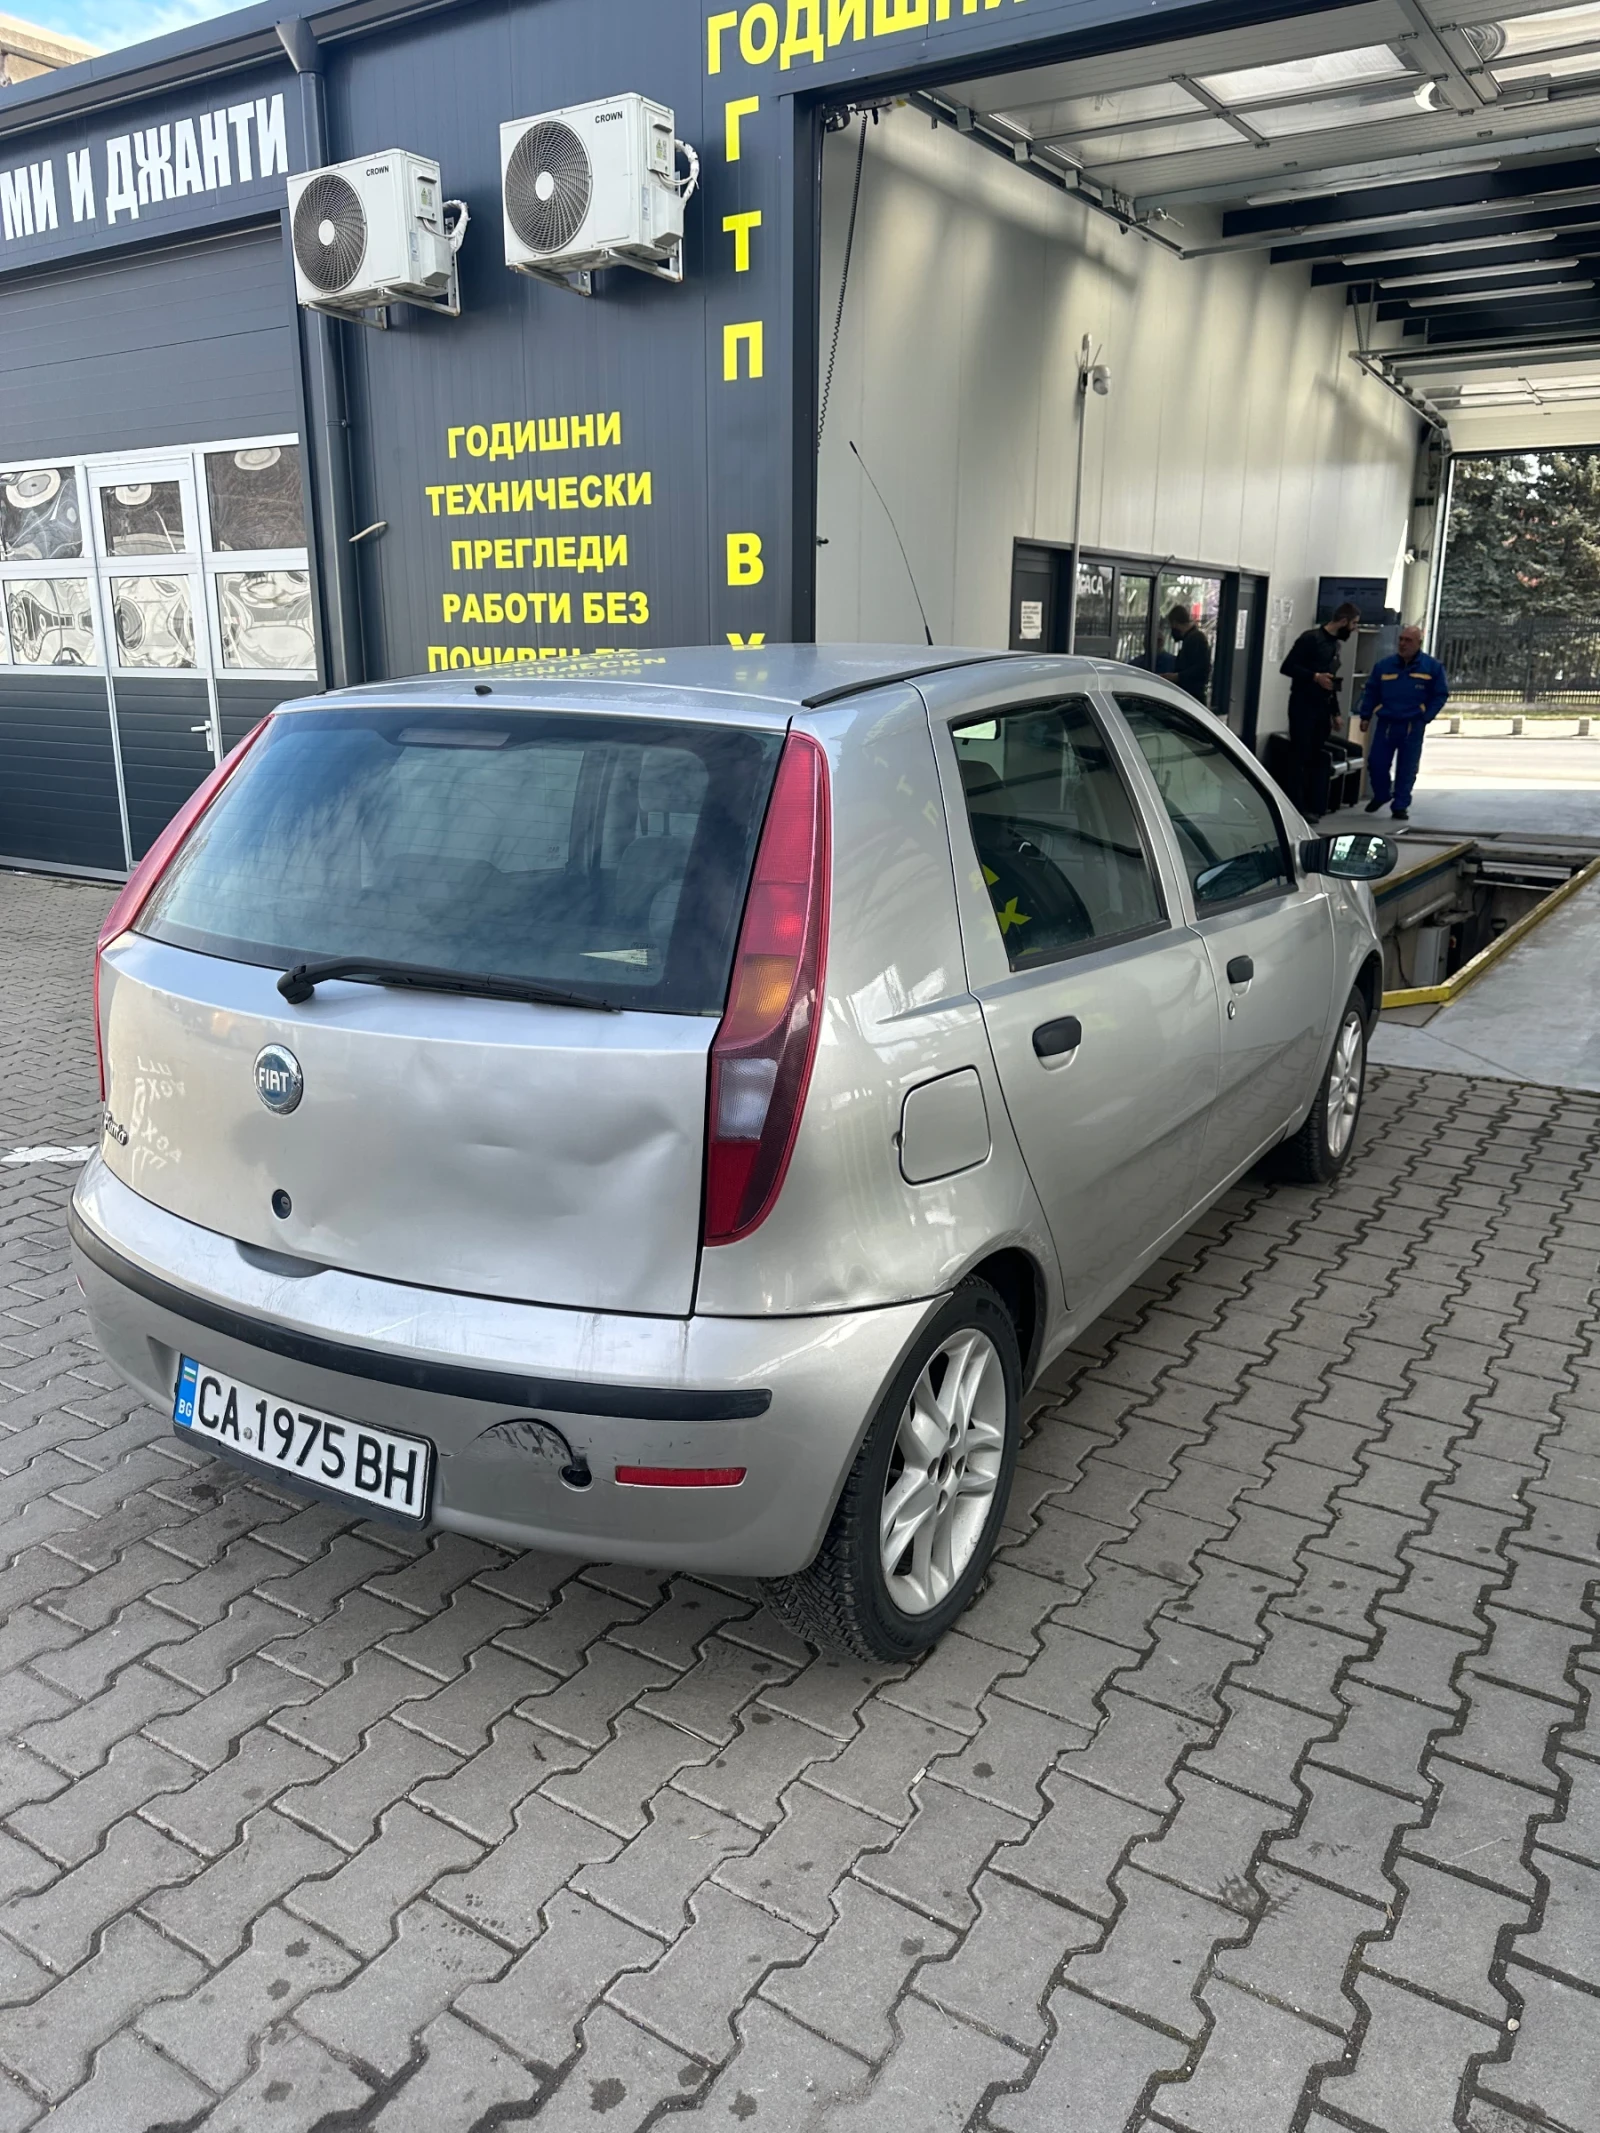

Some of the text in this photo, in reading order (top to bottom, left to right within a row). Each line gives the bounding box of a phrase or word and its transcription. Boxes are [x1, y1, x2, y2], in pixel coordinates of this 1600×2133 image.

[595, 111, 622, 124] CROWN
[66, 147, 96, 223] И
[106, 93, 289, 225] ДЖАНТИ
[366, 165, 389, 176] CROWN
[448, 411, 621, 461] ГОДИШНИ
[425, 471, 653, 516] ТЕХНИЧЕСКИ
[451, 534, 628, 573] ПРЕГЛЕДИ
[442, 591, 650, 624] РАБОТИ БЕЗ
[258, 1066, 290, 1093] FIAT
[178, 1397, 193, 1418] BG
[198, 1375, 417, 1506] CA 1975 BH
